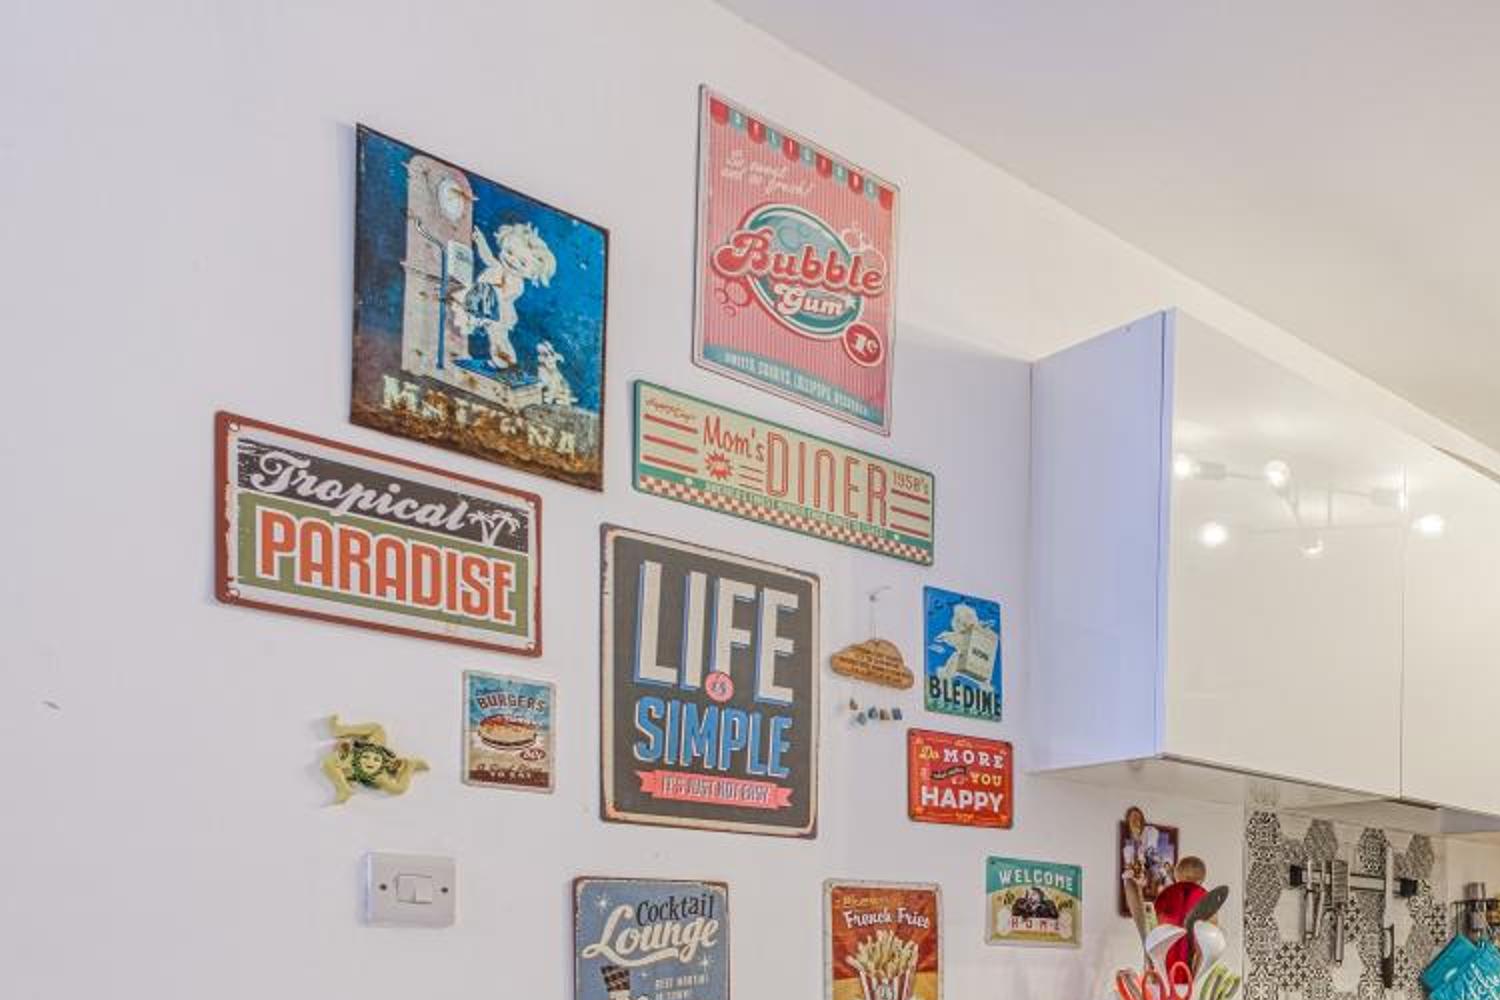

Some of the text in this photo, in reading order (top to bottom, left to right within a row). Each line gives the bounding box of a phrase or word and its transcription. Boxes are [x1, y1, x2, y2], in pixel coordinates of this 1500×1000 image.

[714, 229, 886, 294] Bubble
[774, 283, 843, 315] Gum
[704, 415, 765, 462] Mom's
[767, 431, 888, 527] DINER
[250, 450, 472, 531] Tropical
[259, 508, 515, 625] PARADISE
[634, 560, 799, 705] LIFE
[477, 693, 545, 712] BURGERS
[634, 696, 792, 778] SIMPLE
[944, 748, 1004, 769] MORE
[970, 771, 1002, 786] YOU
[921, 785, 1004, 813] HAPPY
[999, 869, 1073, 891] WELCOME
[637, 893, 714, 926] Cocktail
[843, 907, 929, 928] French Fries
[582, 904, 718, 966] Lounge
